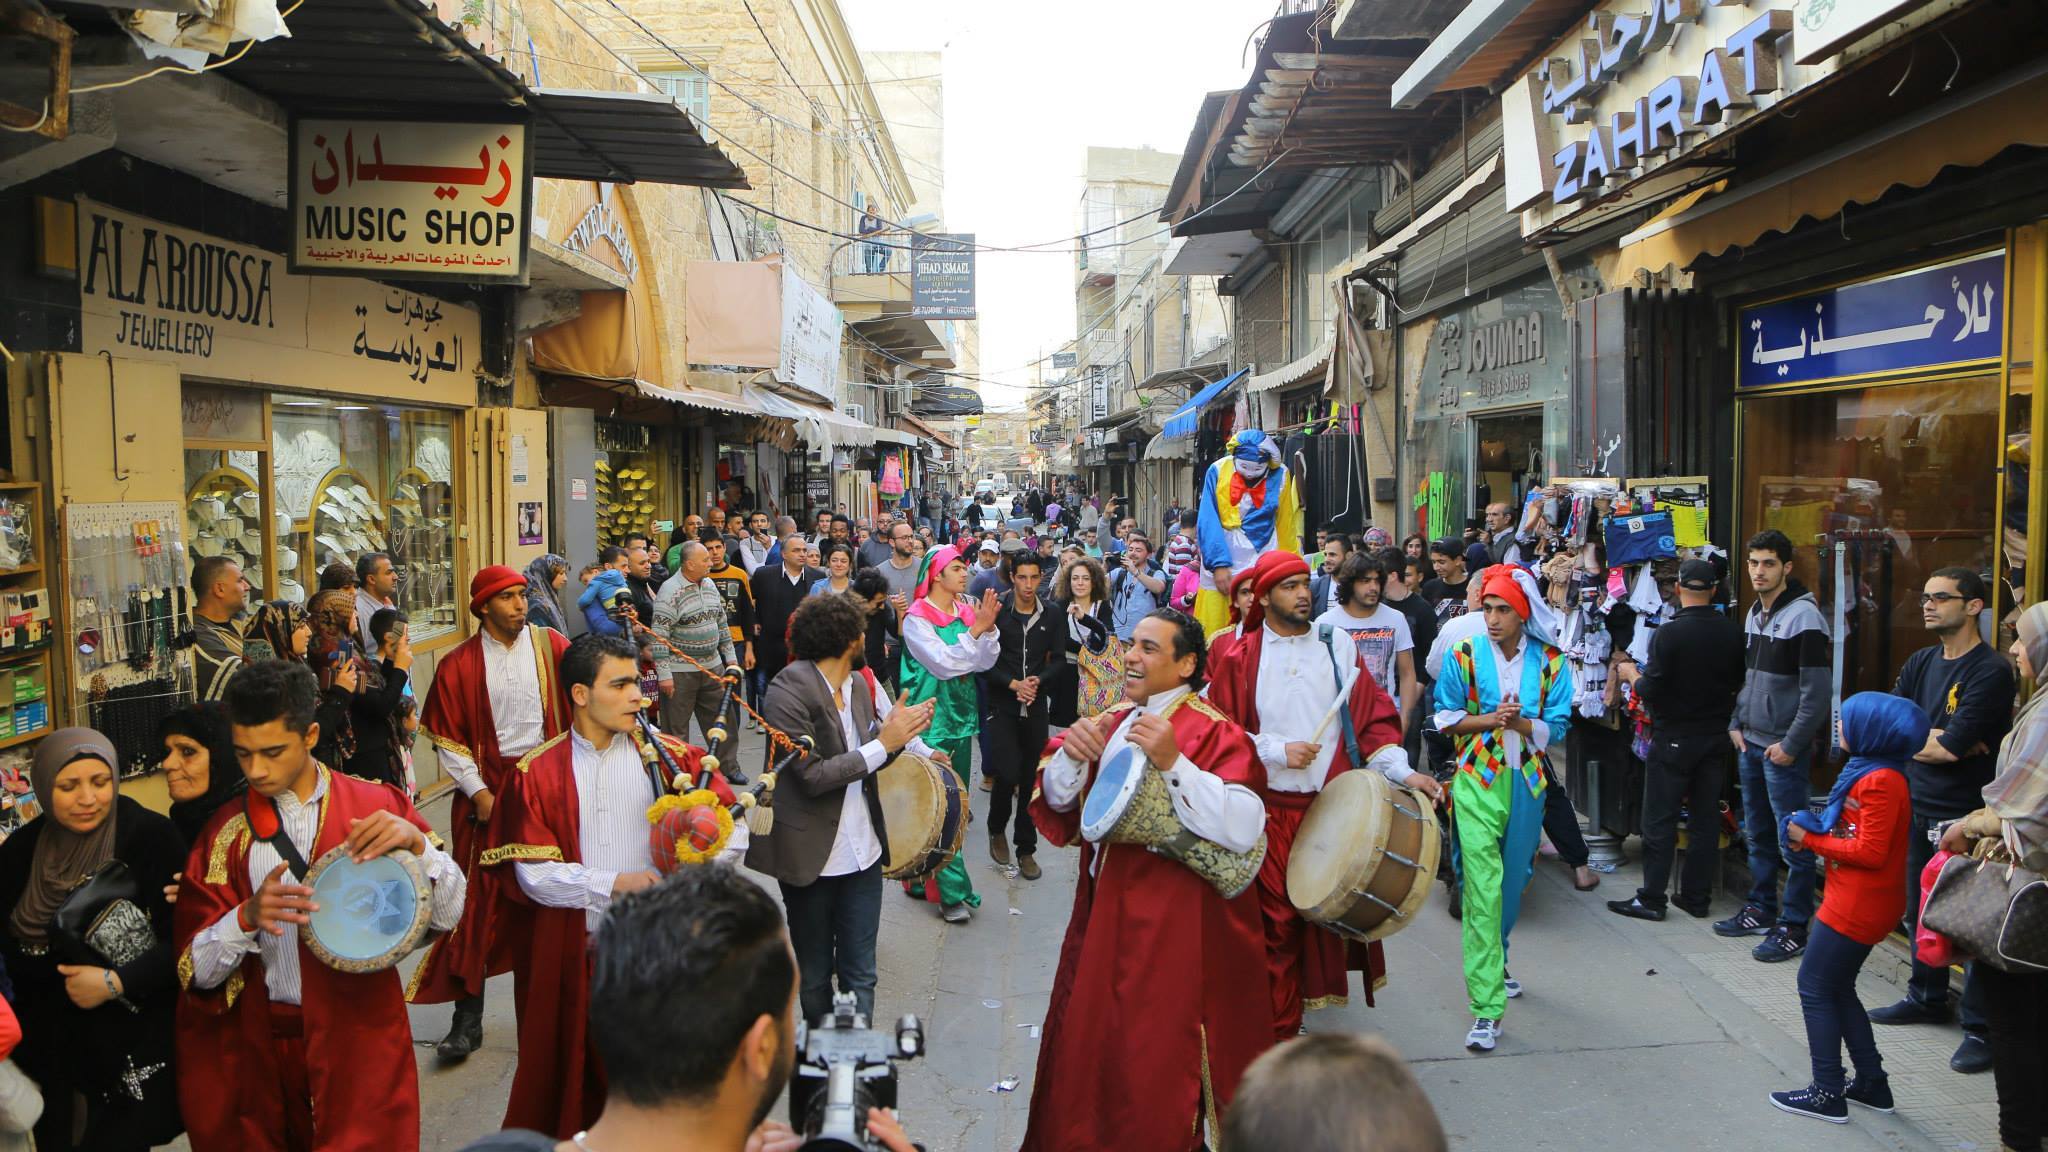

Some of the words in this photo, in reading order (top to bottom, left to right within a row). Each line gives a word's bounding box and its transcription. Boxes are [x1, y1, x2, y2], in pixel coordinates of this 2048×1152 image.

[1551, 8, 1774, 206] ZAHRAT
[311, 127, 512, 207] زيدان
[305, 205, 407, 243] MUSIC
[425, 209, 515, 247] SHOP
[366, 248, 414, 265] العربية
[916, 262, 940, 277] JIHAD
[942, 262, 970, 274] ISMAEL
[116, 310, 214, 358] JEWELLERY
[385, 289, 444, 333] مجوهرات
[1751, 275, 1994, 377] للأحذية
[353, 303, 463, 385] العروسة
[1465, 311, 1543, 374] JOUMAA
[1504, 370, 1529, 393] Shoes
[1668, 498, 1693, 506] NAUTICA
